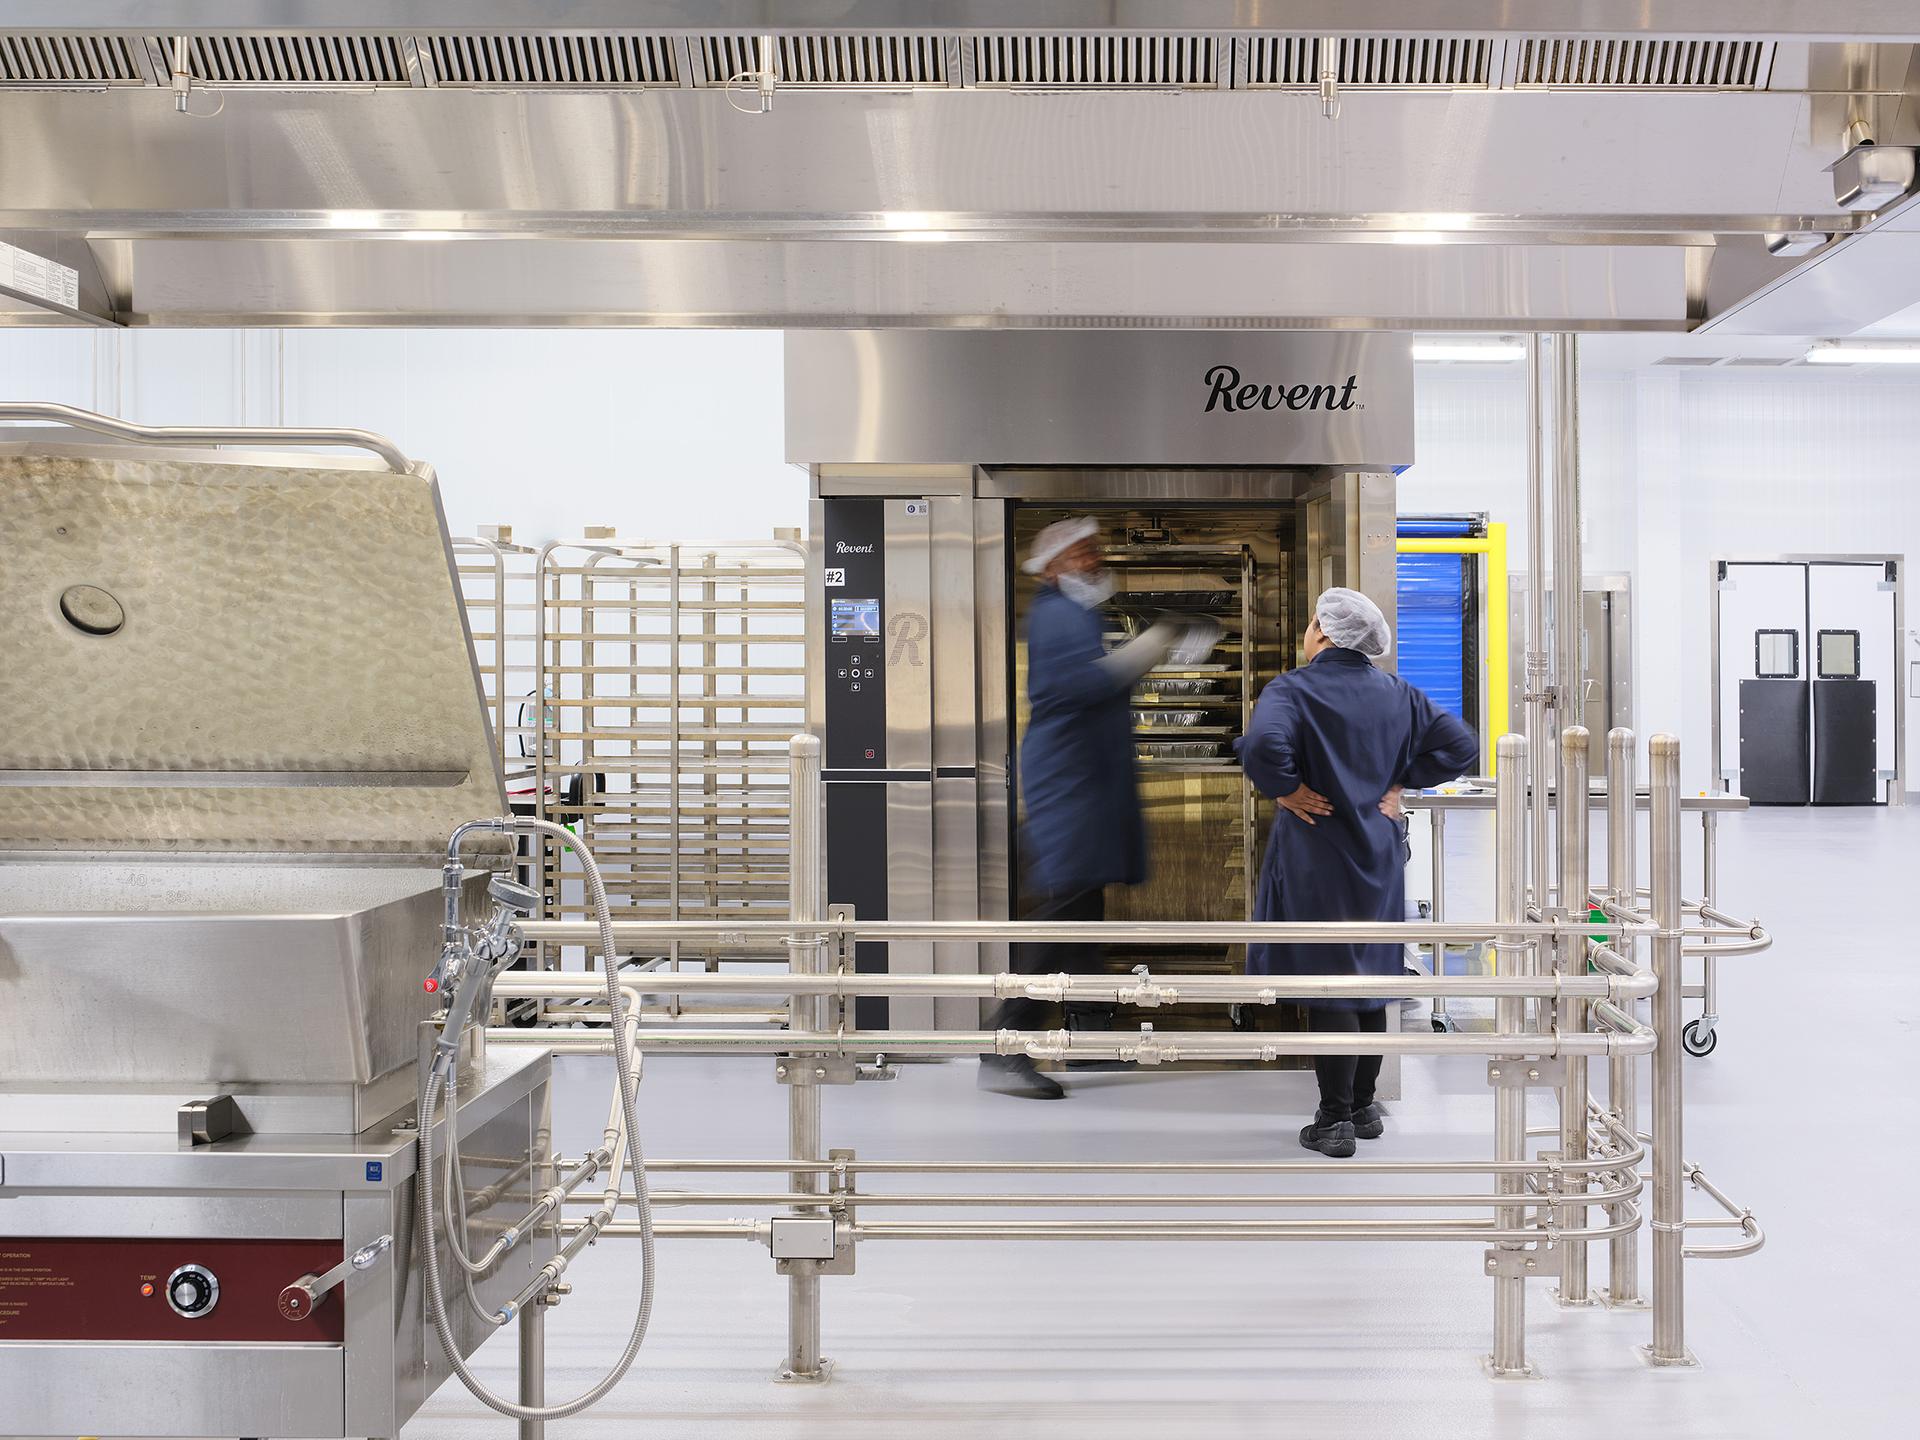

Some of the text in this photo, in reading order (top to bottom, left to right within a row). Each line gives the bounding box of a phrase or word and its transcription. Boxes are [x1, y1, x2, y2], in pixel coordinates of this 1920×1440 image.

[1204, 365, 1358, 412] Revent
[836, 541, 874, 554] Revent
[826, 571, 843, 583] #2
[887, 612, 929, 666] R
